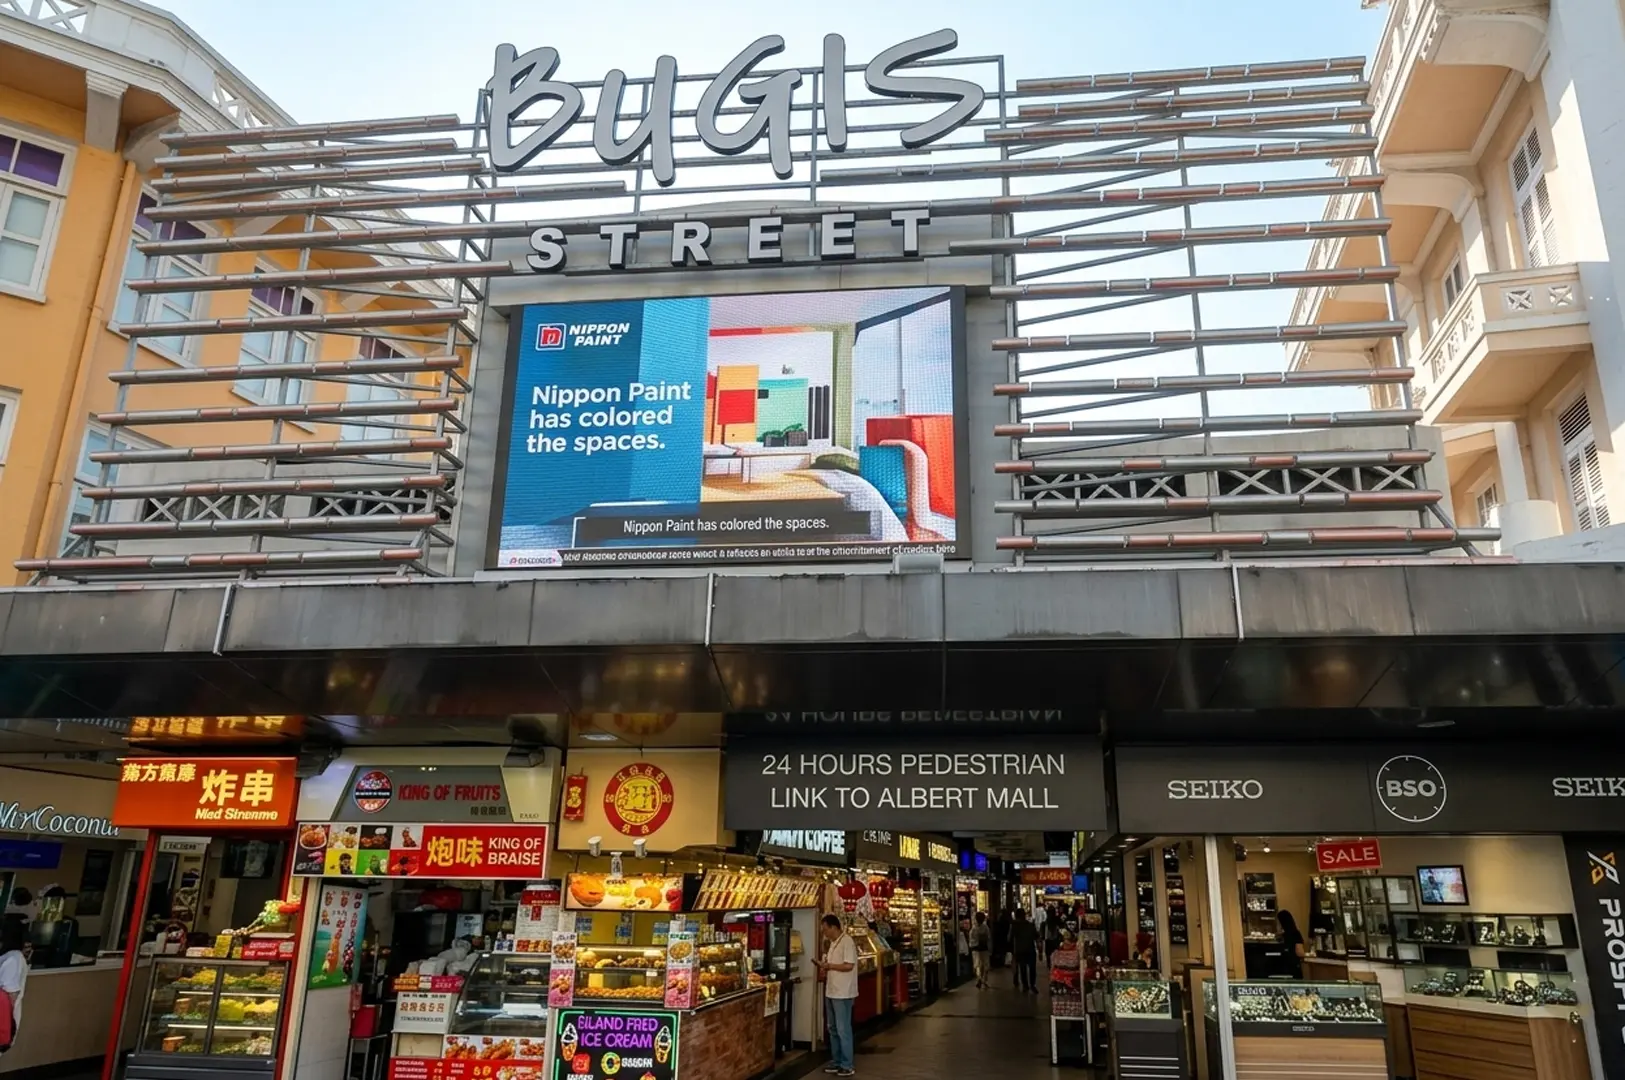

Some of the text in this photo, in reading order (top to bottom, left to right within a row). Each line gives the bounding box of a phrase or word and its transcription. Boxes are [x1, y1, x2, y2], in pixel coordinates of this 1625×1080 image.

[486, 28, 985, 187] BUGIS
[527, 208, 931, 274] STREET
[568, 322, 630, 336] NIPPON
[574, 334, 623, 347] PAINT
[532, 381, 692, 408] Nippon Paint
[529, 405, 673, 429] has colored
[526, 433, 666, 456] the spaces.
[623, 517, 830, 535] Nippon Paint has colored the spaces.
[762, 753, 1065, 775] 24 HOURS PEDESTRIAN
[199, 769, 275, 807] 炸串
[398, 784, 426, 801] KING
[433, 784, 451, 801] OF
[454, 784, 501, 801] FRUITS
[771, 786, 1060, 809] LINK TO ALBERT MALL
[1167, 779, 1264, 800] SEIKO
[1385, 779, 1437, 797] BSO
[425, 836, 484, 867] 炮味
[488, 837, 542, 850] KING OF
[487, 852, 541, 865] BRAISE
[1322, 846, 1377, 864] SALE
[580, 1032, 653, 1048] ICE CREAM
